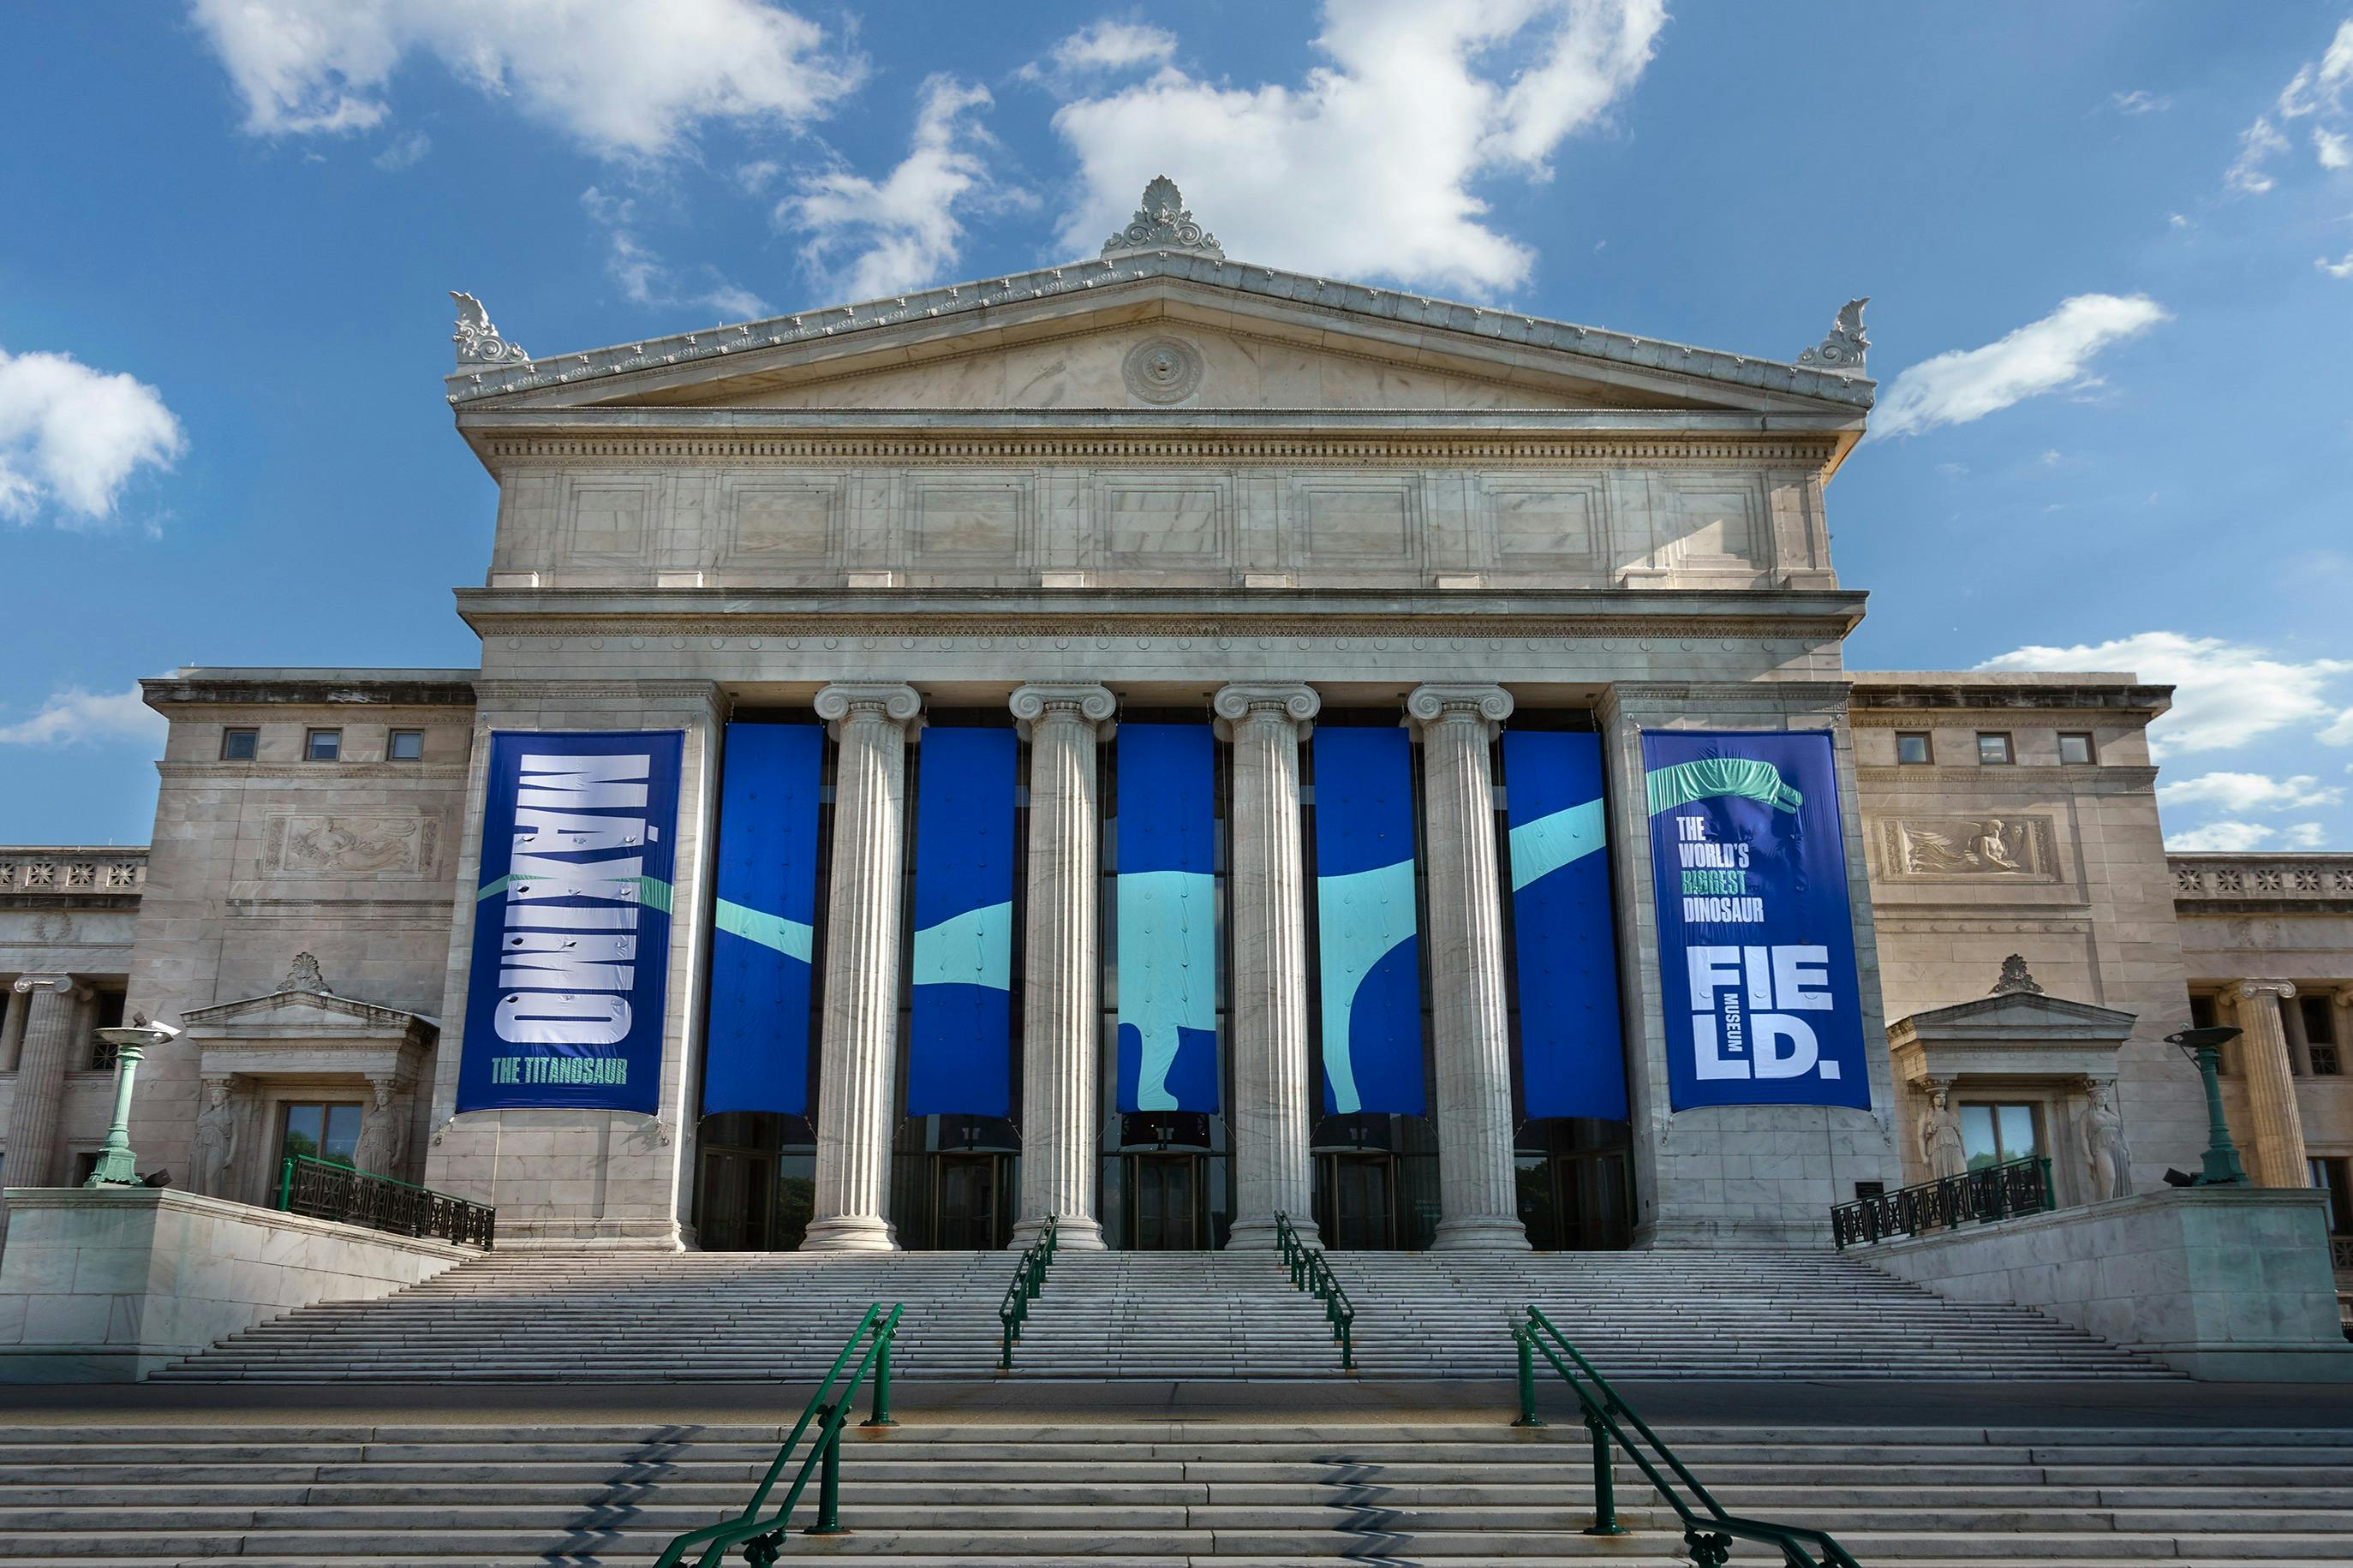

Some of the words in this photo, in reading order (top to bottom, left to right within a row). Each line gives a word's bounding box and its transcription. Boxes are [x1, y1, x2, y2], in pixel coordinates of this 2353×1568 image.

[1676, 816, 1707, 841] THE
[1679, 843, 1749, 868] WORLD'S
[1681, 870, 1747, 895] BIGGEST
[495, 754, 659, 1044] MÁXIMO
[1683, 897, 1765, 923] DINOSAUR
[1687, 945, 1833, 1011] FIE
[1724, 993, 1742, 1052] MUSEUM
[492, 1058, 521, 1084] THE
[524, 1057, 628, 1085] TITANOSAUR
